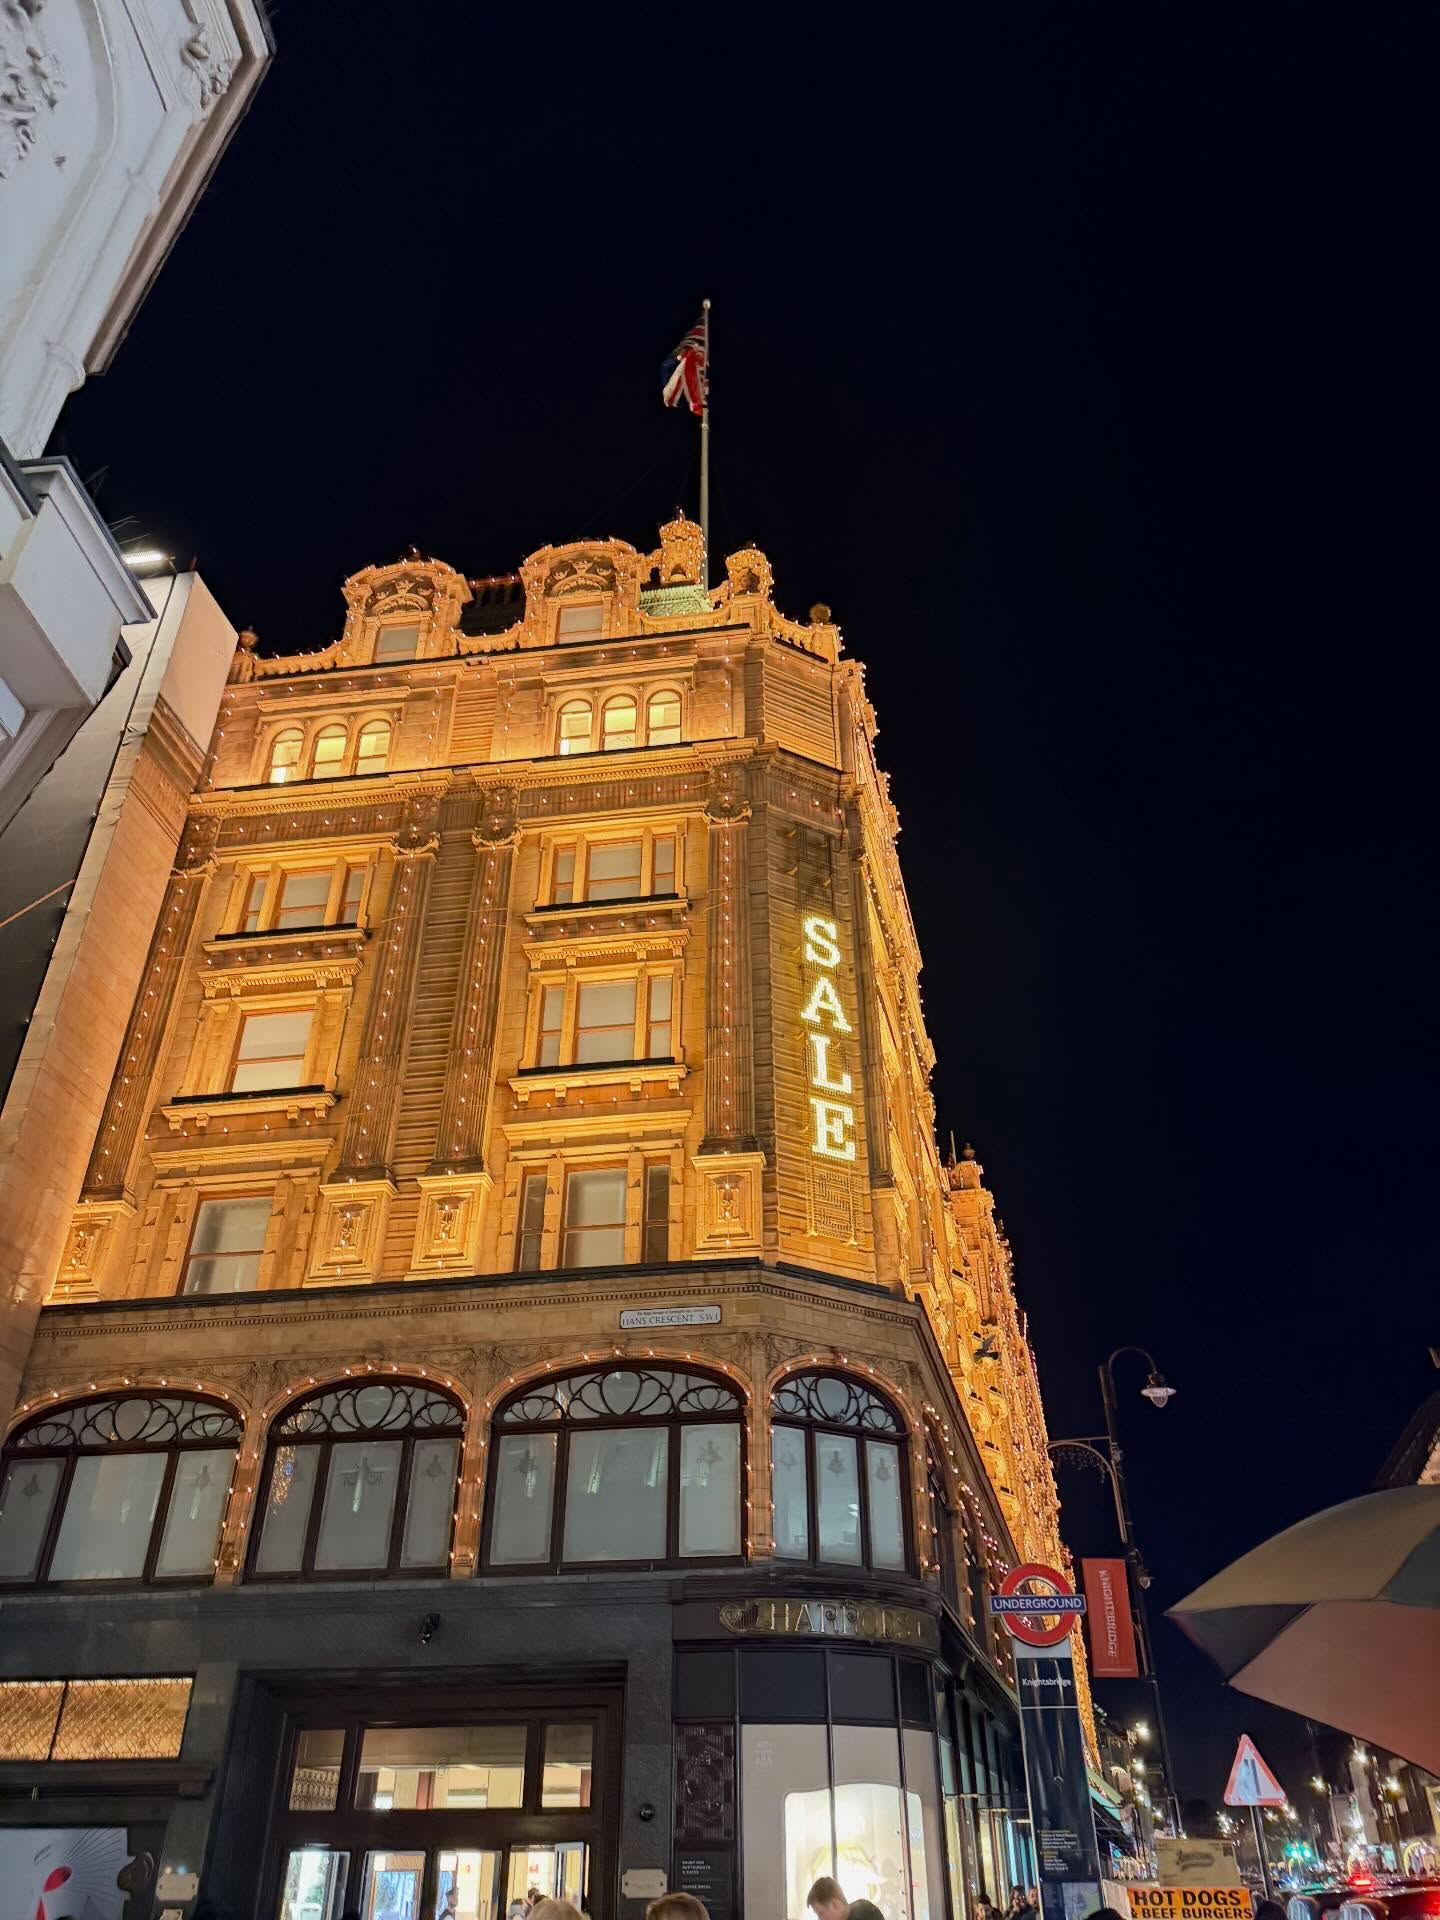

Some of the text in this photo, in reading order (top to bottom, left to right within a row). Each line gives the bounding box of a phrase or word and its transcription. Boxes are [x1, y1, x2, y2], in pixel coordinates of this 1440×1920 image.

[801, 917, 856, 1161] SALE
[622, 1316, 647, 1326] HANS
[994, 1598, 1082, 1609] UNDERGROUND
[765, 1600, 914, 1640] HARRODS
[1022, 1678, 1072, 1687] Knightsbridge
[1133, 1889, 1241, 1906] HOT DOGS
[1141, 1907, 1177, 1919] BEEF
[1181, 1907, 1253, 1920] BURGERS
